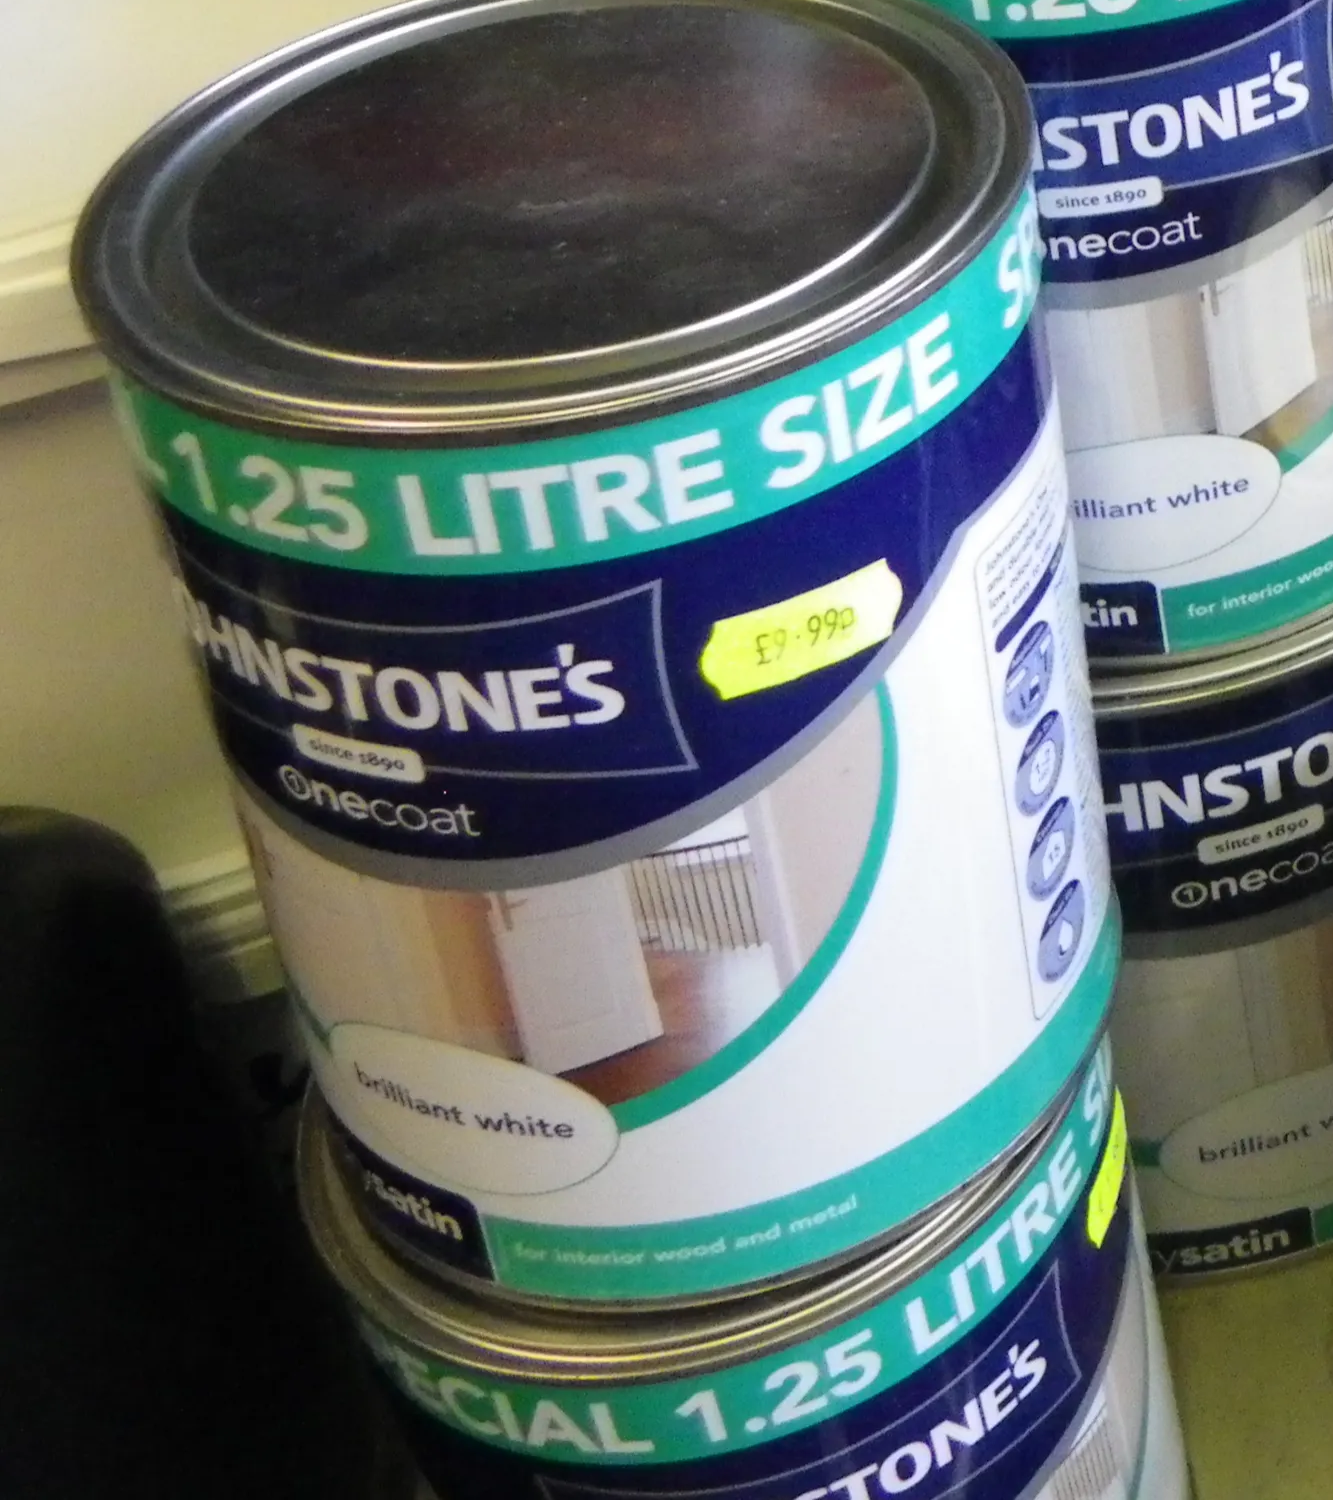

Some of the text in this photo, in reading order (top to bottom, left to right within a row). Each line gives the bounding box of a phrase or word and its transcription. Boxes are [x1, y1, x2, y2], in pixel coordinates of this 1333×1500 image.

[1033, 52, 1312, 176] STONE'S
[1055, 186, 1147, 209] since 1890
[169, 311, 960, 558] 1.25 LITRE SIZE
[1166, 473, 1251, 509] white
[1187, 600, 1215, 620] for
[1219, 579, 1293, 612] interior
[305, 734, 407, 774] since 1890
[1213, 812, 1311, 855] since 1890
[352, 1060, 576, 1140] brilliant white
[1198, 1122, 1312, 1165] brilliant
[512, 1193, 859, 1267] for interior wood and metal
[675, 1329, 885, 1444] 1.25
[902, 1143, 1083, 1358] LITRE
